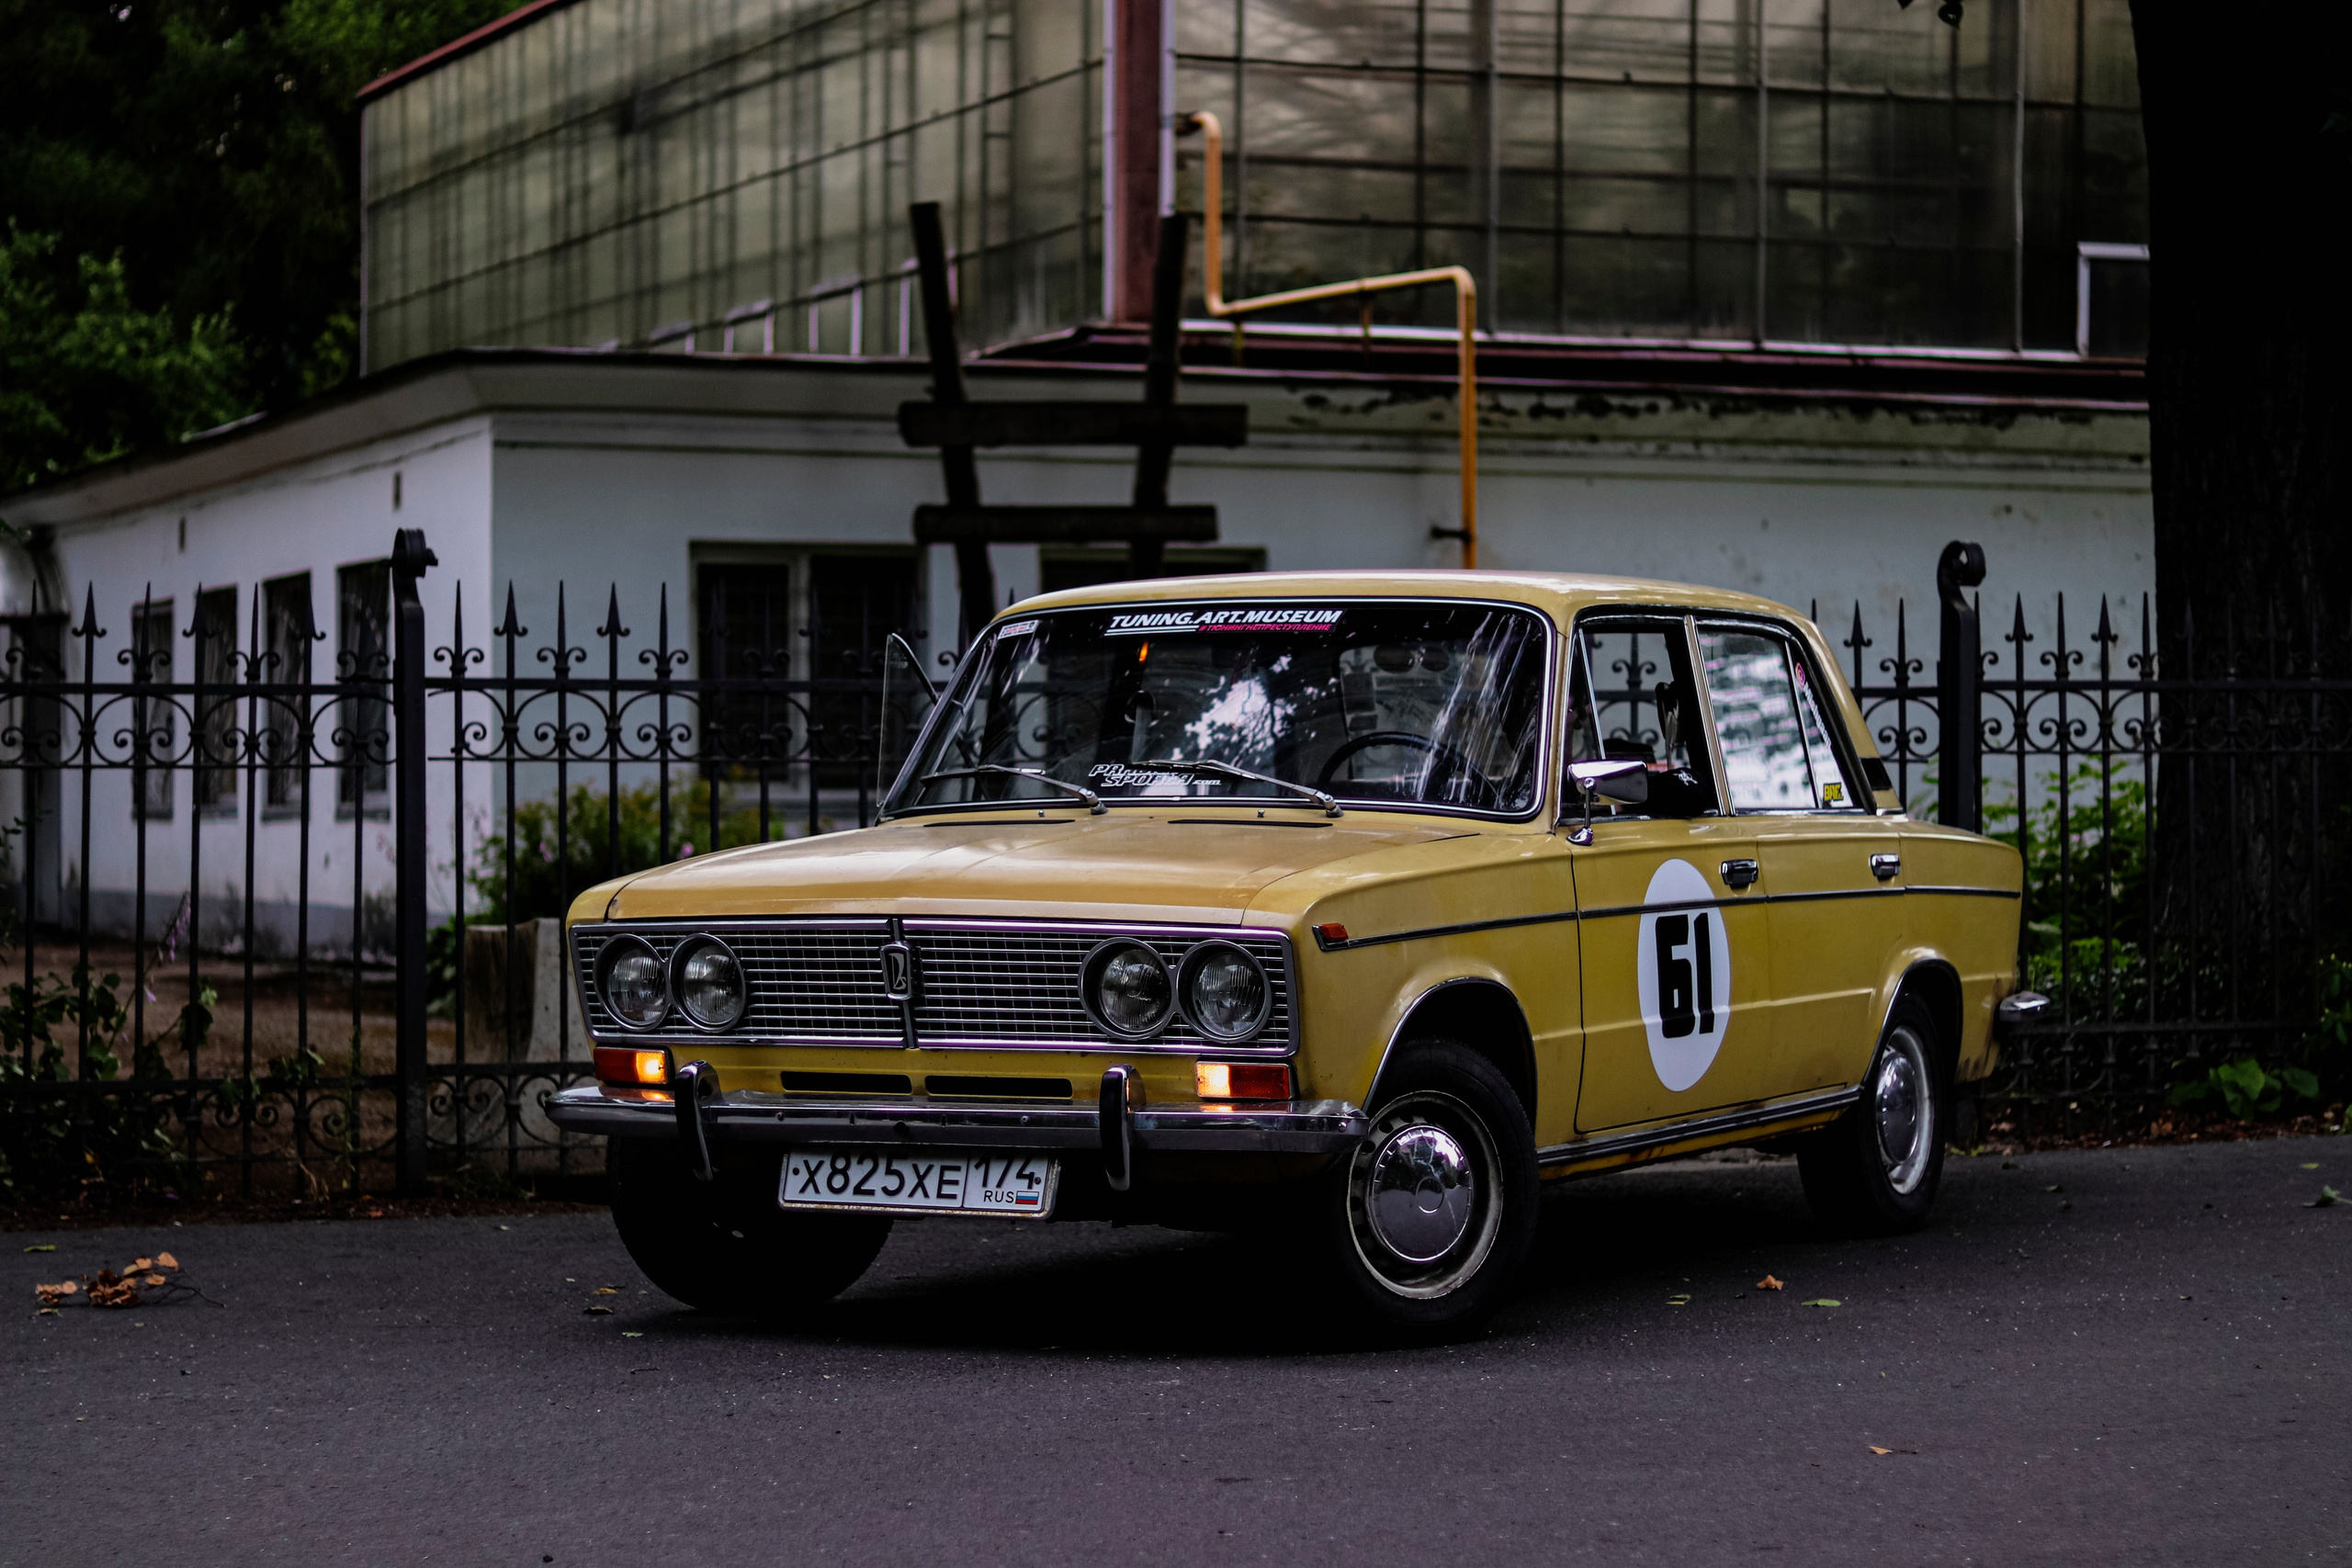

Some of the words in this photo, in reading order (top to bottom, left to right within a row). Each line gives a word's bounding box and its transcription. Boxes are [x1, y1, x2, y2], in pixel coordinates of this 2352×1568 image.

[1110, 610, 1343, 628] TUNING.ART.MUSEUM
[1655, 912, 1715, 1040] 61
[974, 1152, 1035, 1190] 174
[983, 1190, 1014, 1203] RUS
